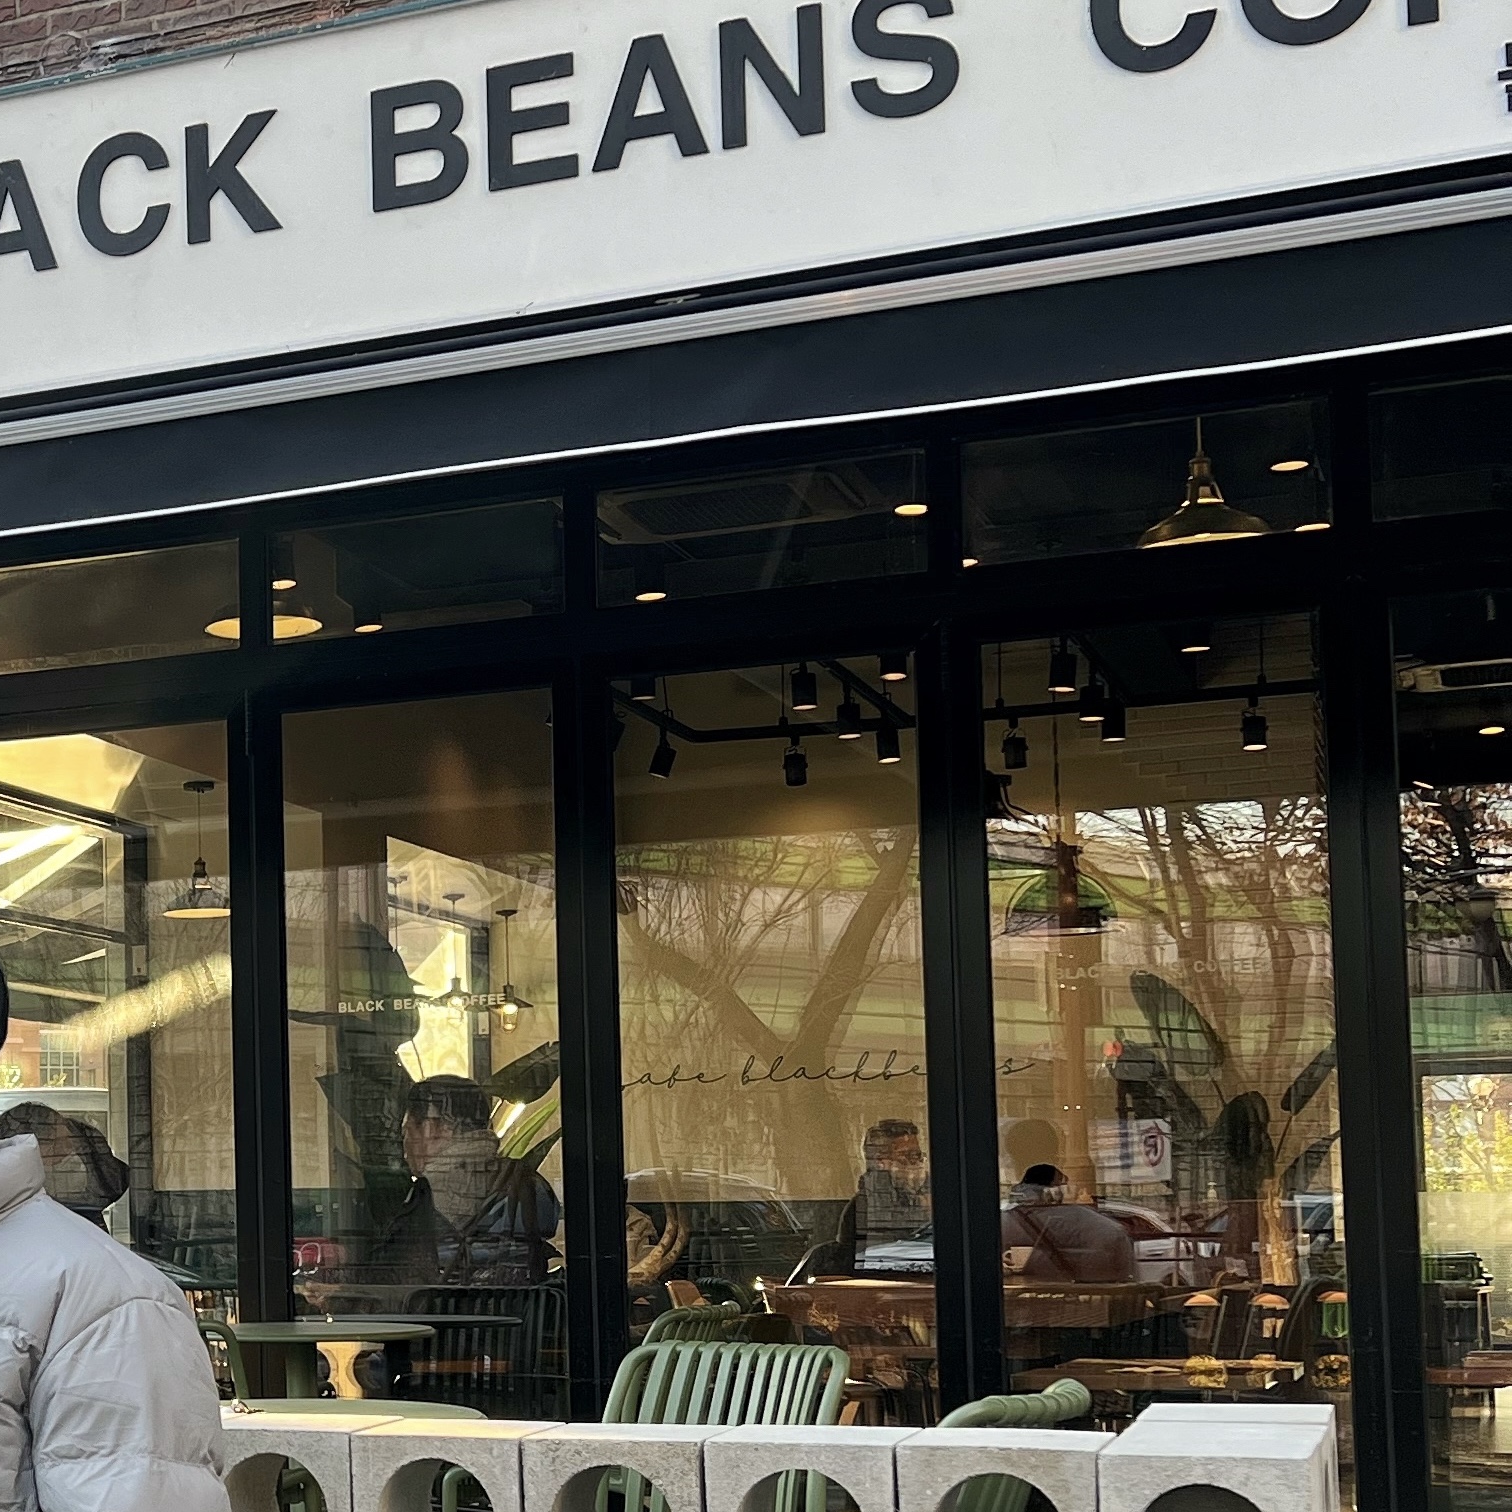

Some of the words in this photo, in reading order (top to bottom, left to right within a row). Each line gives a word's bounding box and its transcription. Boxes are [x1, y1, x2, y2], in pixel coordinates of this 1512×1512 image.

[371, 0, 959, 212] BEANS
[338, 1000, 385, 1014] BLACK
[622, 1064, 727, 1090] afe
[740, 1050, 1036, 1084] blackbes
